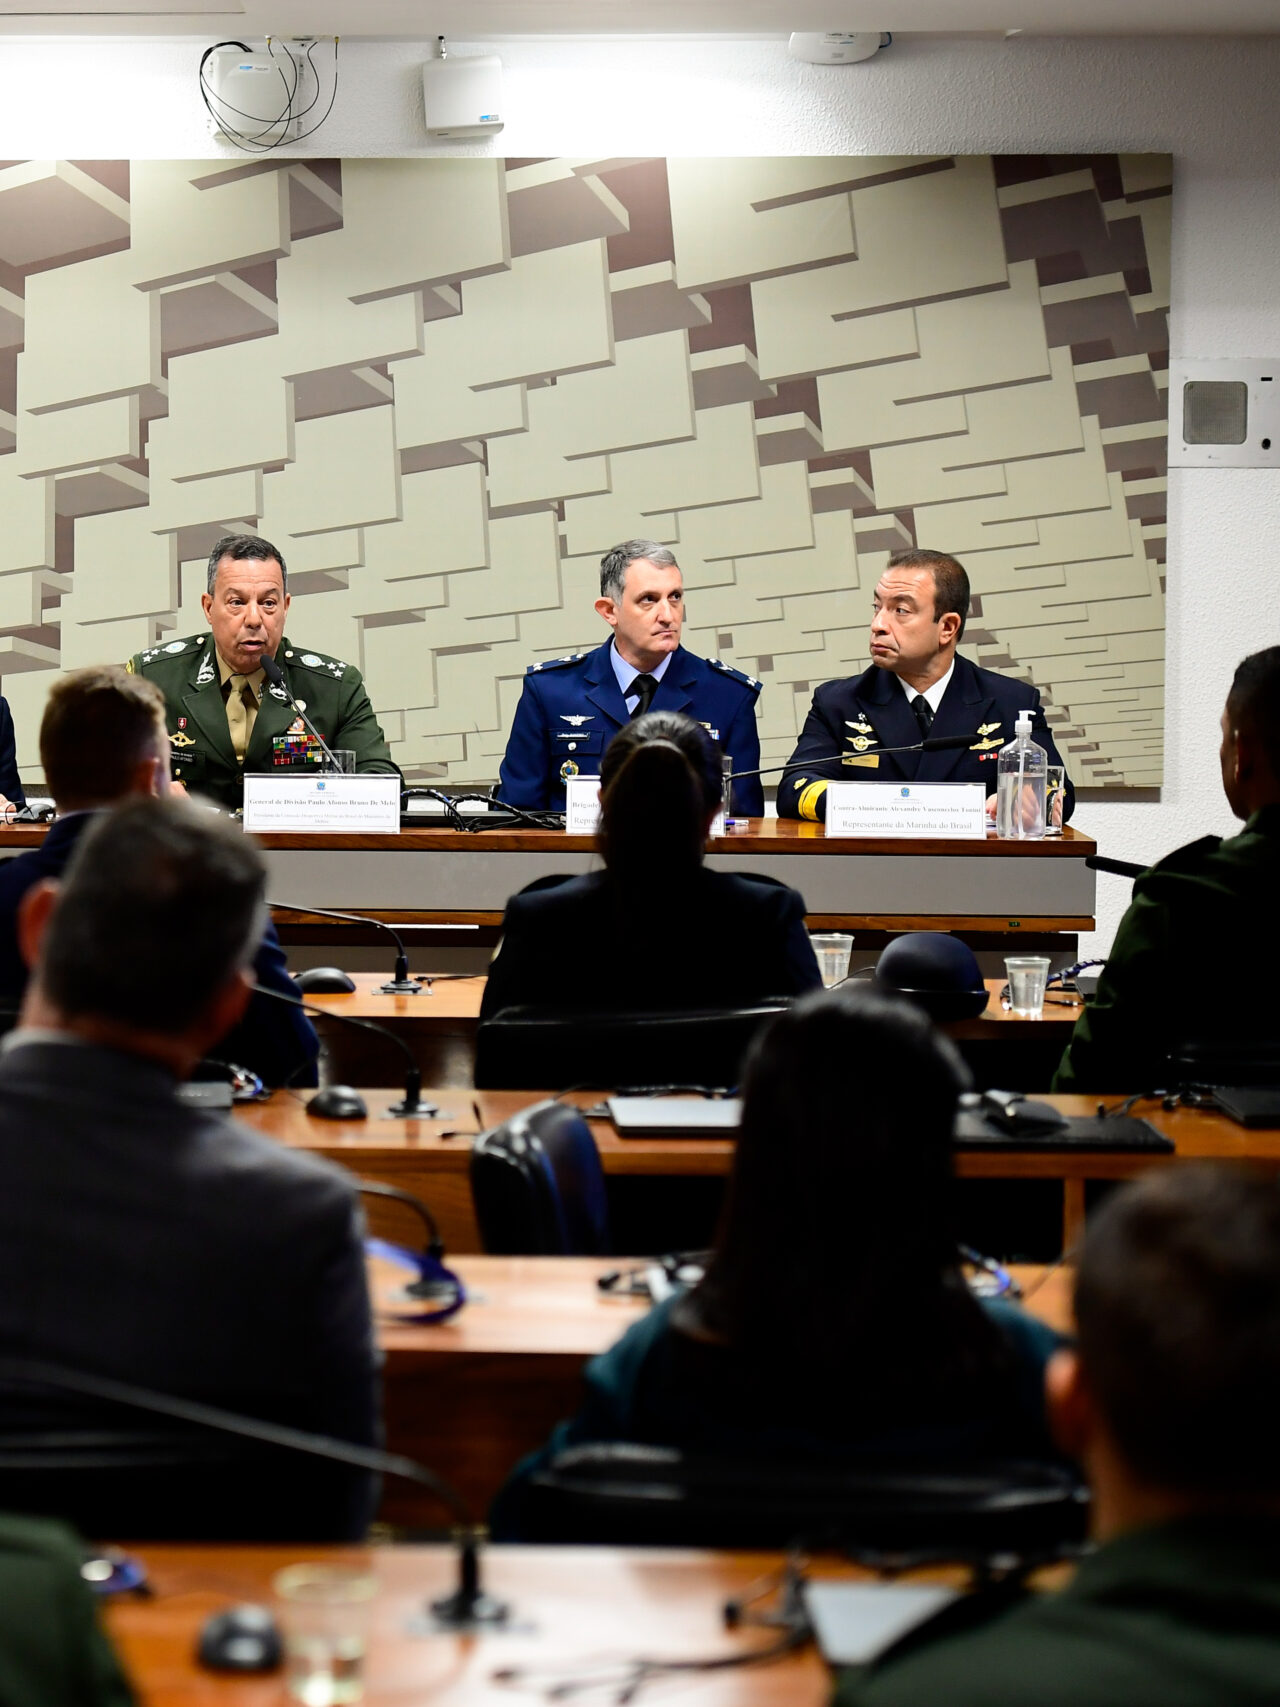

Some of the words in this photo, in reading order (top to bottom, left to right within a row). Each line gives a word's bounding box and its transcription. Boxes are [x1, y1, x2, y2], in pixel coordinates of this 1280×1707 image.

[842, 820, 893, 830] Representante
[895, 820, 905, 829] da
[906, 821, 937, 829] Marinha
[938, 821, 948, 829] do
[950, 821, 972, 830] Brasil
